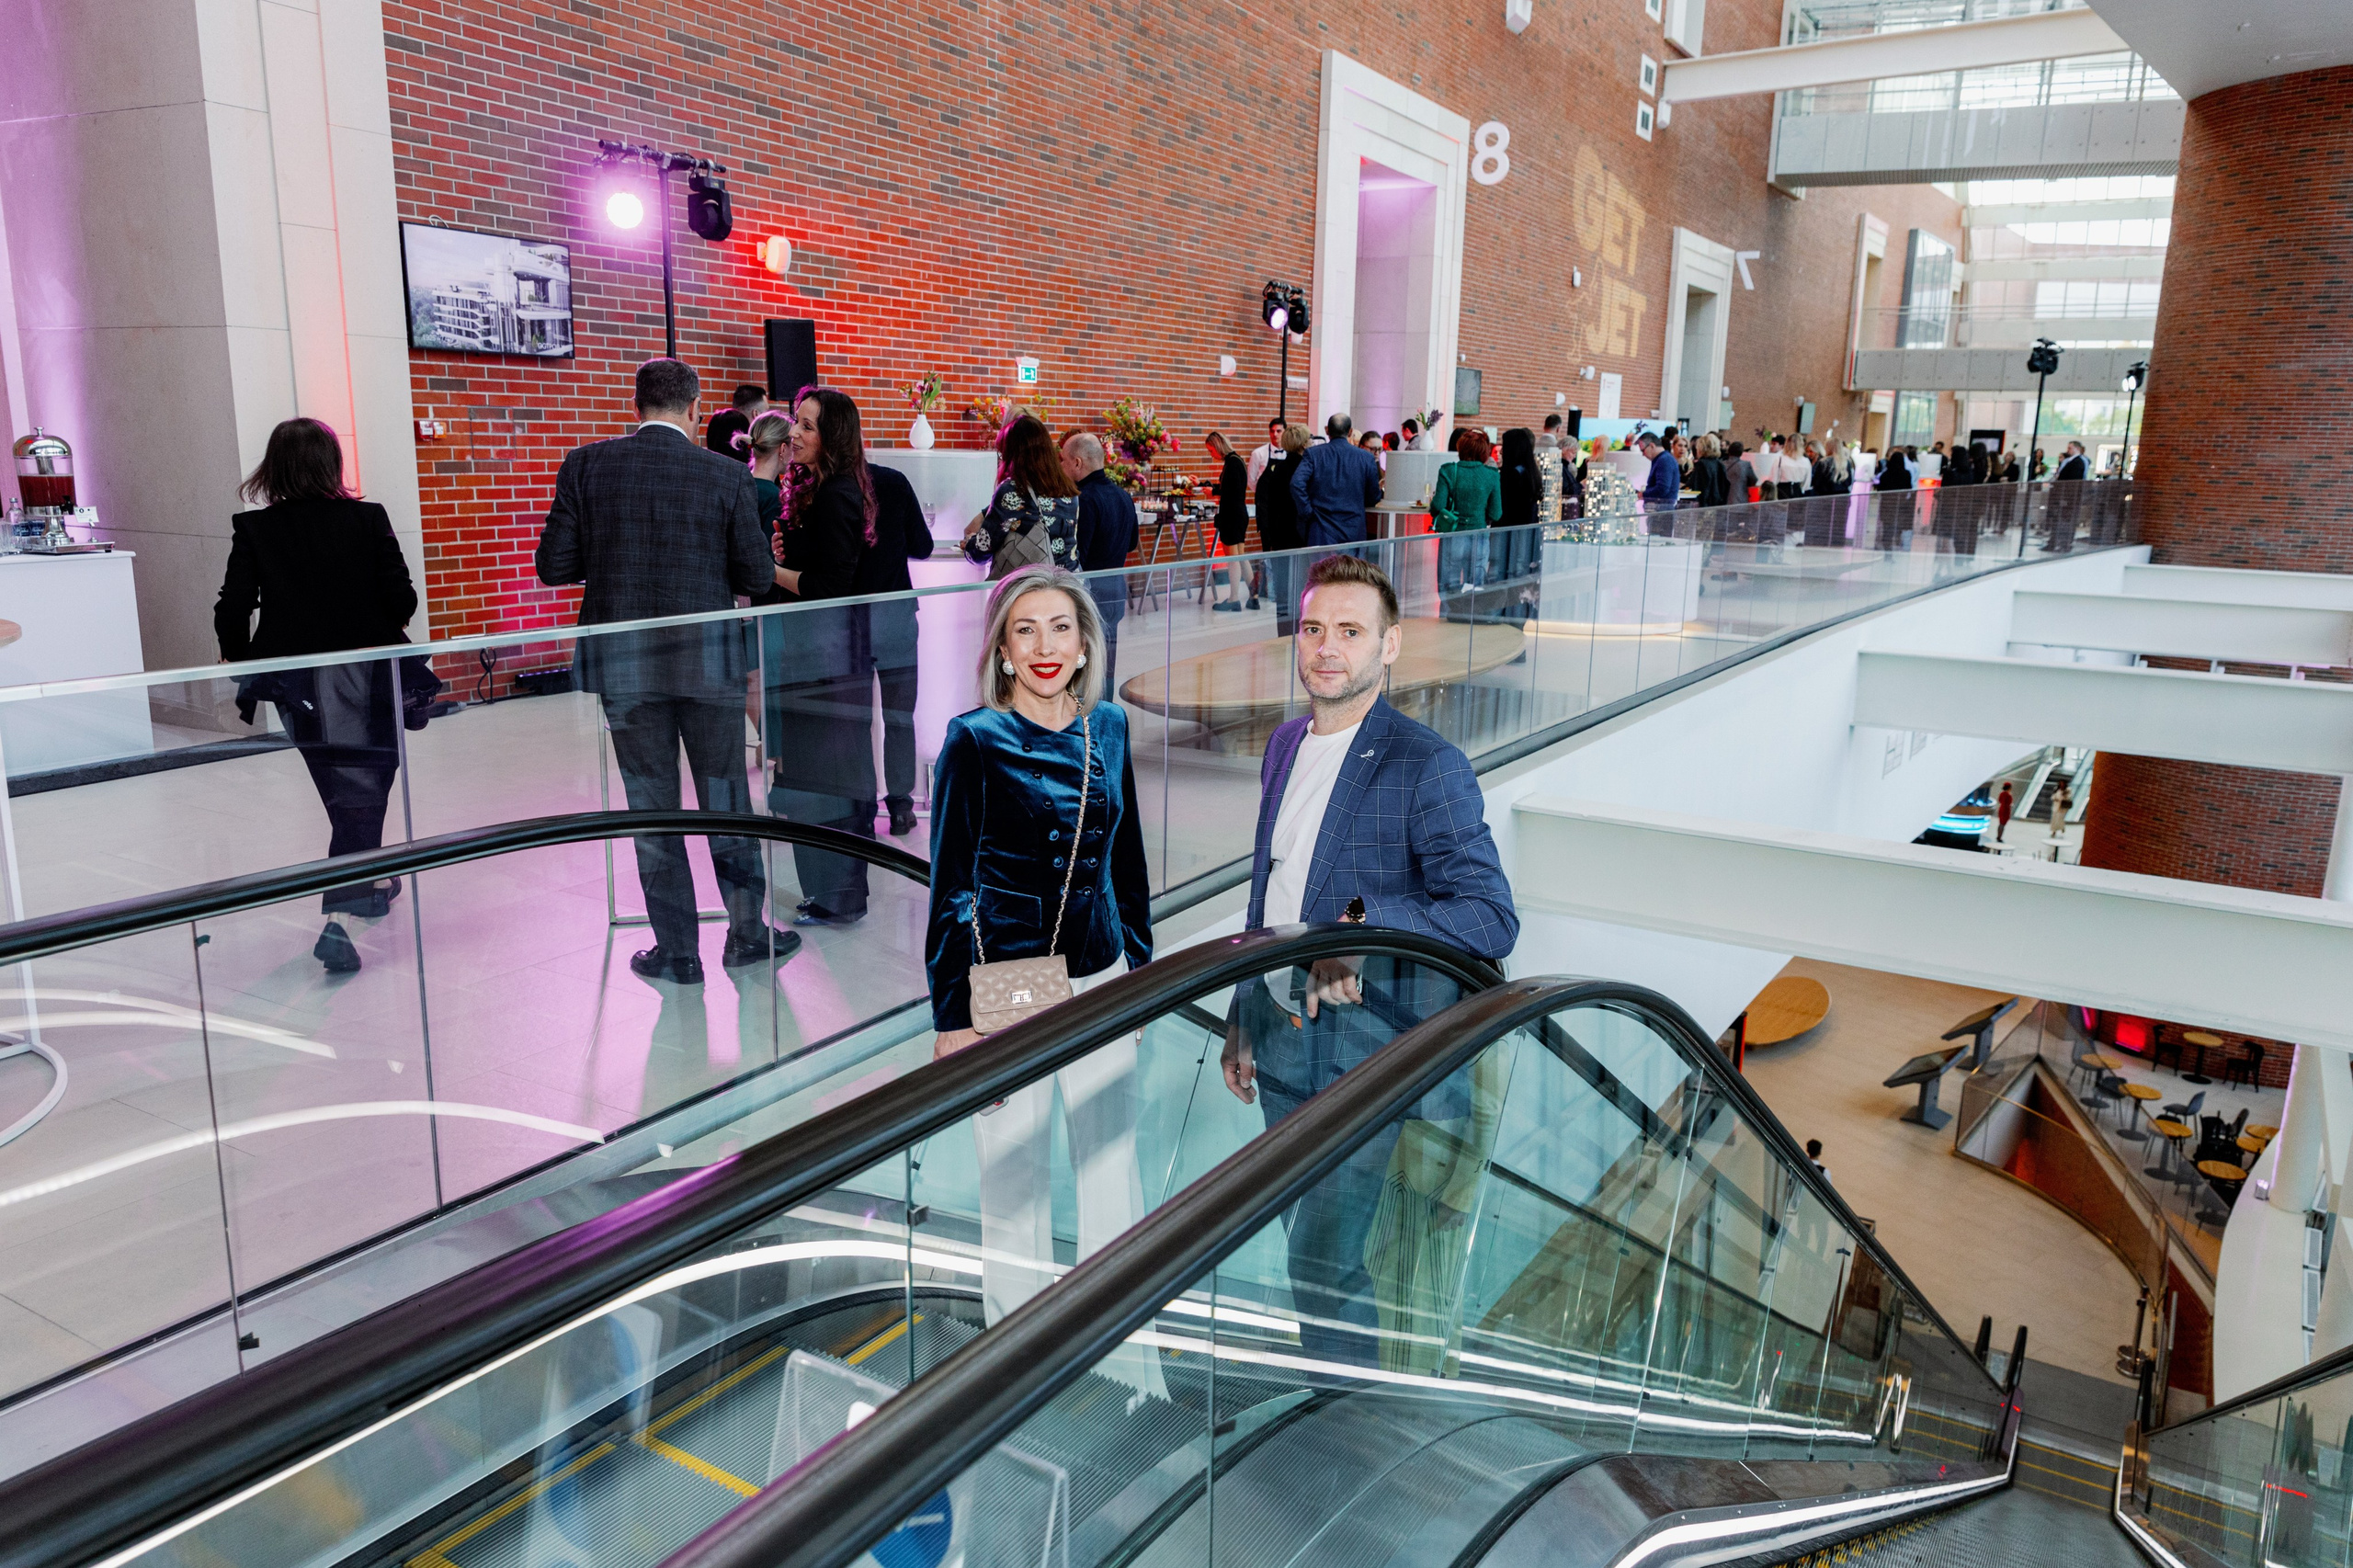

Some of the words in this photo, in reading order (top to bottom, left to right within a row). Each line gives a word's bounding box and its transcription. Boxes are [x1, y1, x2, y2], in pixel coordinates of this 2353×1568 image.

[1471, 120, 1510, 185] 8
[1573, 144, 1646, 276] GET
[1735, 250, 1760, 290] 7
[1586, 274, 1647, 358] JET
